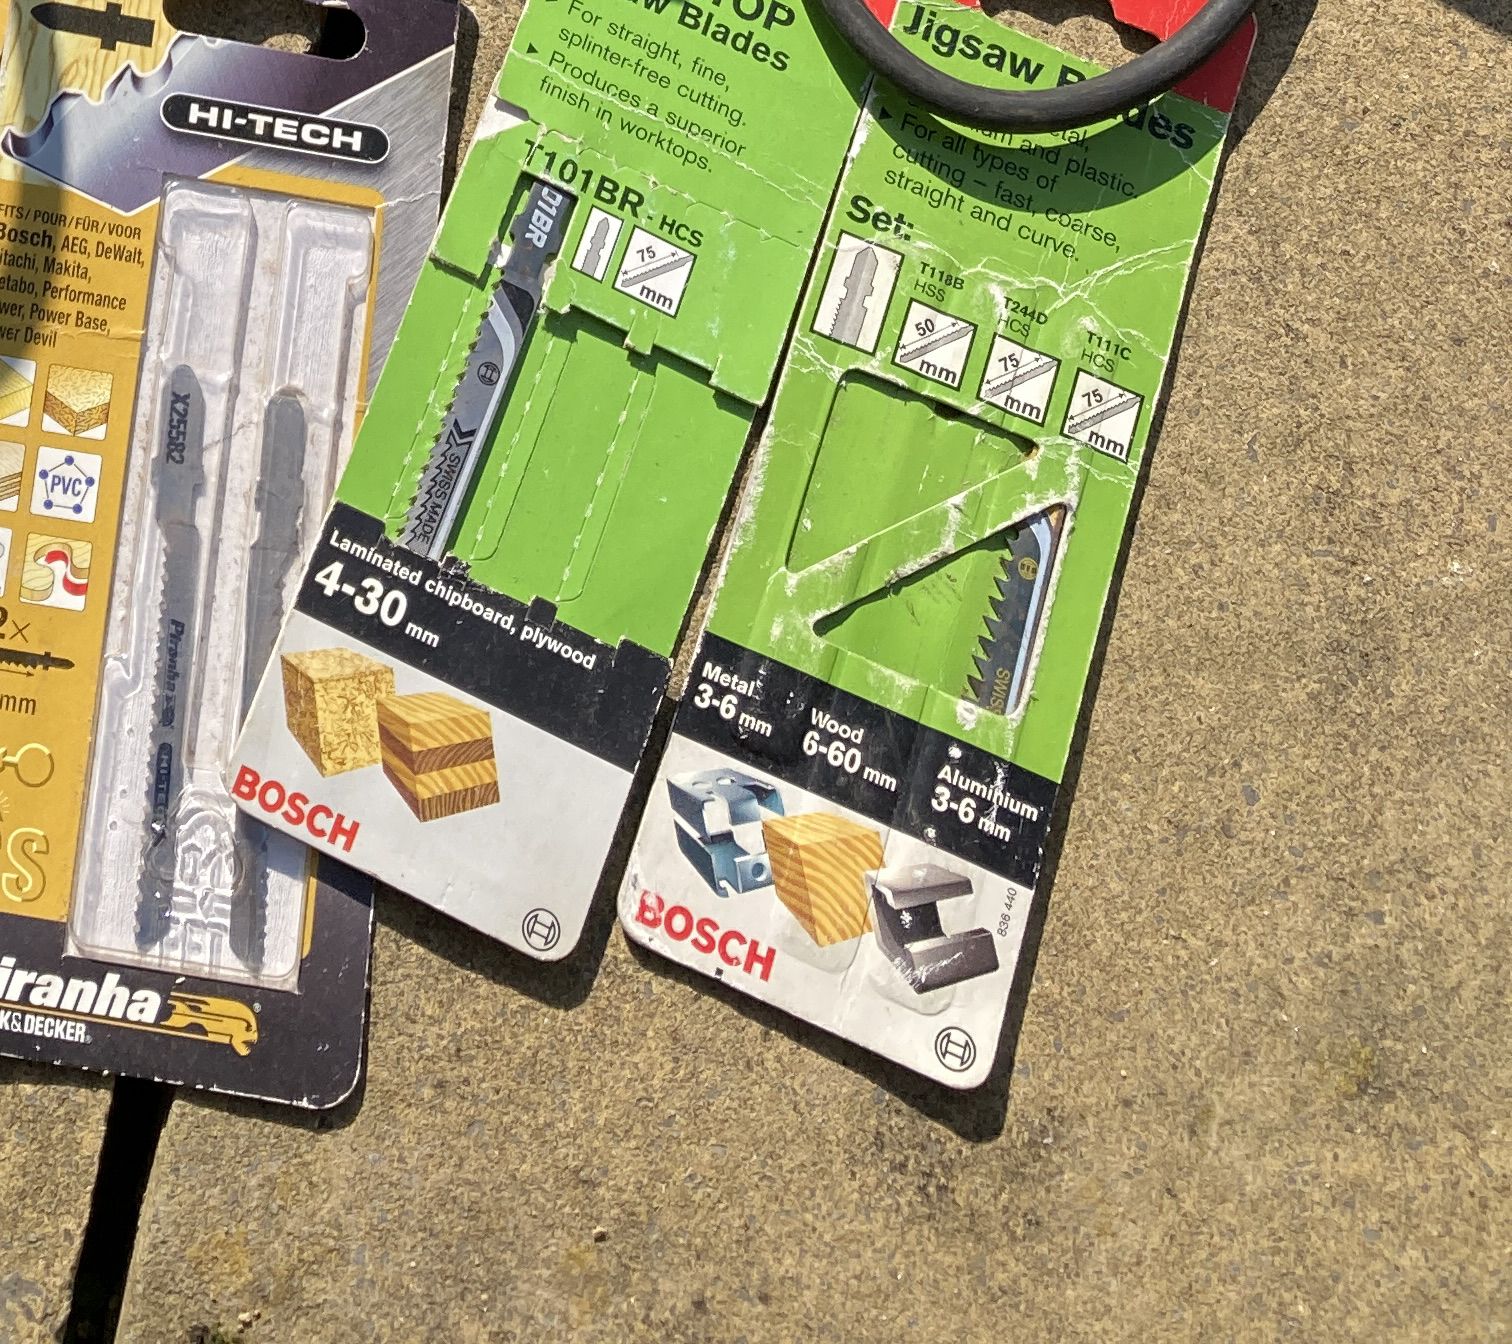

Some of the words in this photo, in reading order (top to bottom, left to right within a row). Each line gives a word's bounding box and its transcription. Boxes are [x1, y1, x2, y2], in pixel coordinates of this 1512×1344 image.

[606, 22, 682, 70] straight,
[690, 56, 729, 91] fine,
[677, 1, 791, 72] Blades
[902, 4, 1045, 85] Jigsaw
[558, 28, 671, 89] splinter-free
[677, 84, 746, 128] cutting.
[188, 102, 363, 152] HI-TECH
[539, 75, 590, 113] finish
[595, 106, 613, 124] in
[620, 116, 712, 174] worktops.
[548, 50, 642, 109] Produces
[645, 102, 659, 118] a
[664, 111, 747, 157] superior
[899, 112, 939, 144] For
[941, 128, 969, 156] all
[972, 141, 1030, 182] types
[1035, 174, 1059, 193] of
[1018, 138, 1062, 165] and
[1064, 157, 1139, 200] plastic.
[520, 138, 645, 218] T101BR
[656, 214, 706, 249] HCS
[884, 169, 966, 214] straight
[969, 205, 1013, 232] and
[1017, 224, 1079, 262] curve.
[892, 142, 966, 189] cutting
[993, 180, 1038, 215] fast,
[1045, 207, 1120, 253] coarse,
[845, 194, 915, 242] Set:
[42, 256, 92, 282] Makita,
[60, 234, 91, 258] AEG,
[94, 241, 145, 267] DeWalt,
[636, 245, 657, 266] 75
[42, 280, 127, 311] Performance
[639, 284, 674, 310] mm
[913, 278, 946, 303] HSS
[920, 261, 965, 290] T118B
[29, 303, 71, 326] Power
[74, 311, 111, 335] Base,
[914, 318, 937, 340] 50
[997, 314, 1032, 339] HCS
[1004, 297, 1049, 326] T244D
[23, 326, 58, 348] Devil
[1080, 347, 1116, 373] HCS
[1087, 330, 1133, 361] T111C
[918, 359, 957, 385] mm
[997, 352, 1021, 376] 75
[1003, 394, 1042, 420] mm
[1081, 388, 1104, 411] 75
[165, 391, 190, 465] X25582
[1086, 430, 1125, 457] mm
[49, 474, 83, 498] PVC
[434, 452, 462, 502] SWISS
[416, 500, 443, 545] MADE
[314, 561, 408, 627] 4-30
[404, 621, 440, 648] mm
[329, 529, 423, 586] Laminated
[424, 579, 516, 636] chipboard,
[519, 624, 597, 670] plywood
[701, 661, 759, 698] Metal
[693, 682, 739, 720] 3-6
[738, 712, 773, 738] mm
[811, 707, 865, 745] Wood
[802, 730, 862, 774] 6-60
[862, 766, 897, 792] mm
[231, 765, 361, 853] BOSCH
[930, 784, 977, 824] 3-6
[977, 815, 1012, 843] mm
[936, 764, 1044, 822] Aluminium
[635, 889, 777, 981] BOSCH
[996, 912, 1011, 937] 836
[1004, 887, 1018, 911] 440
